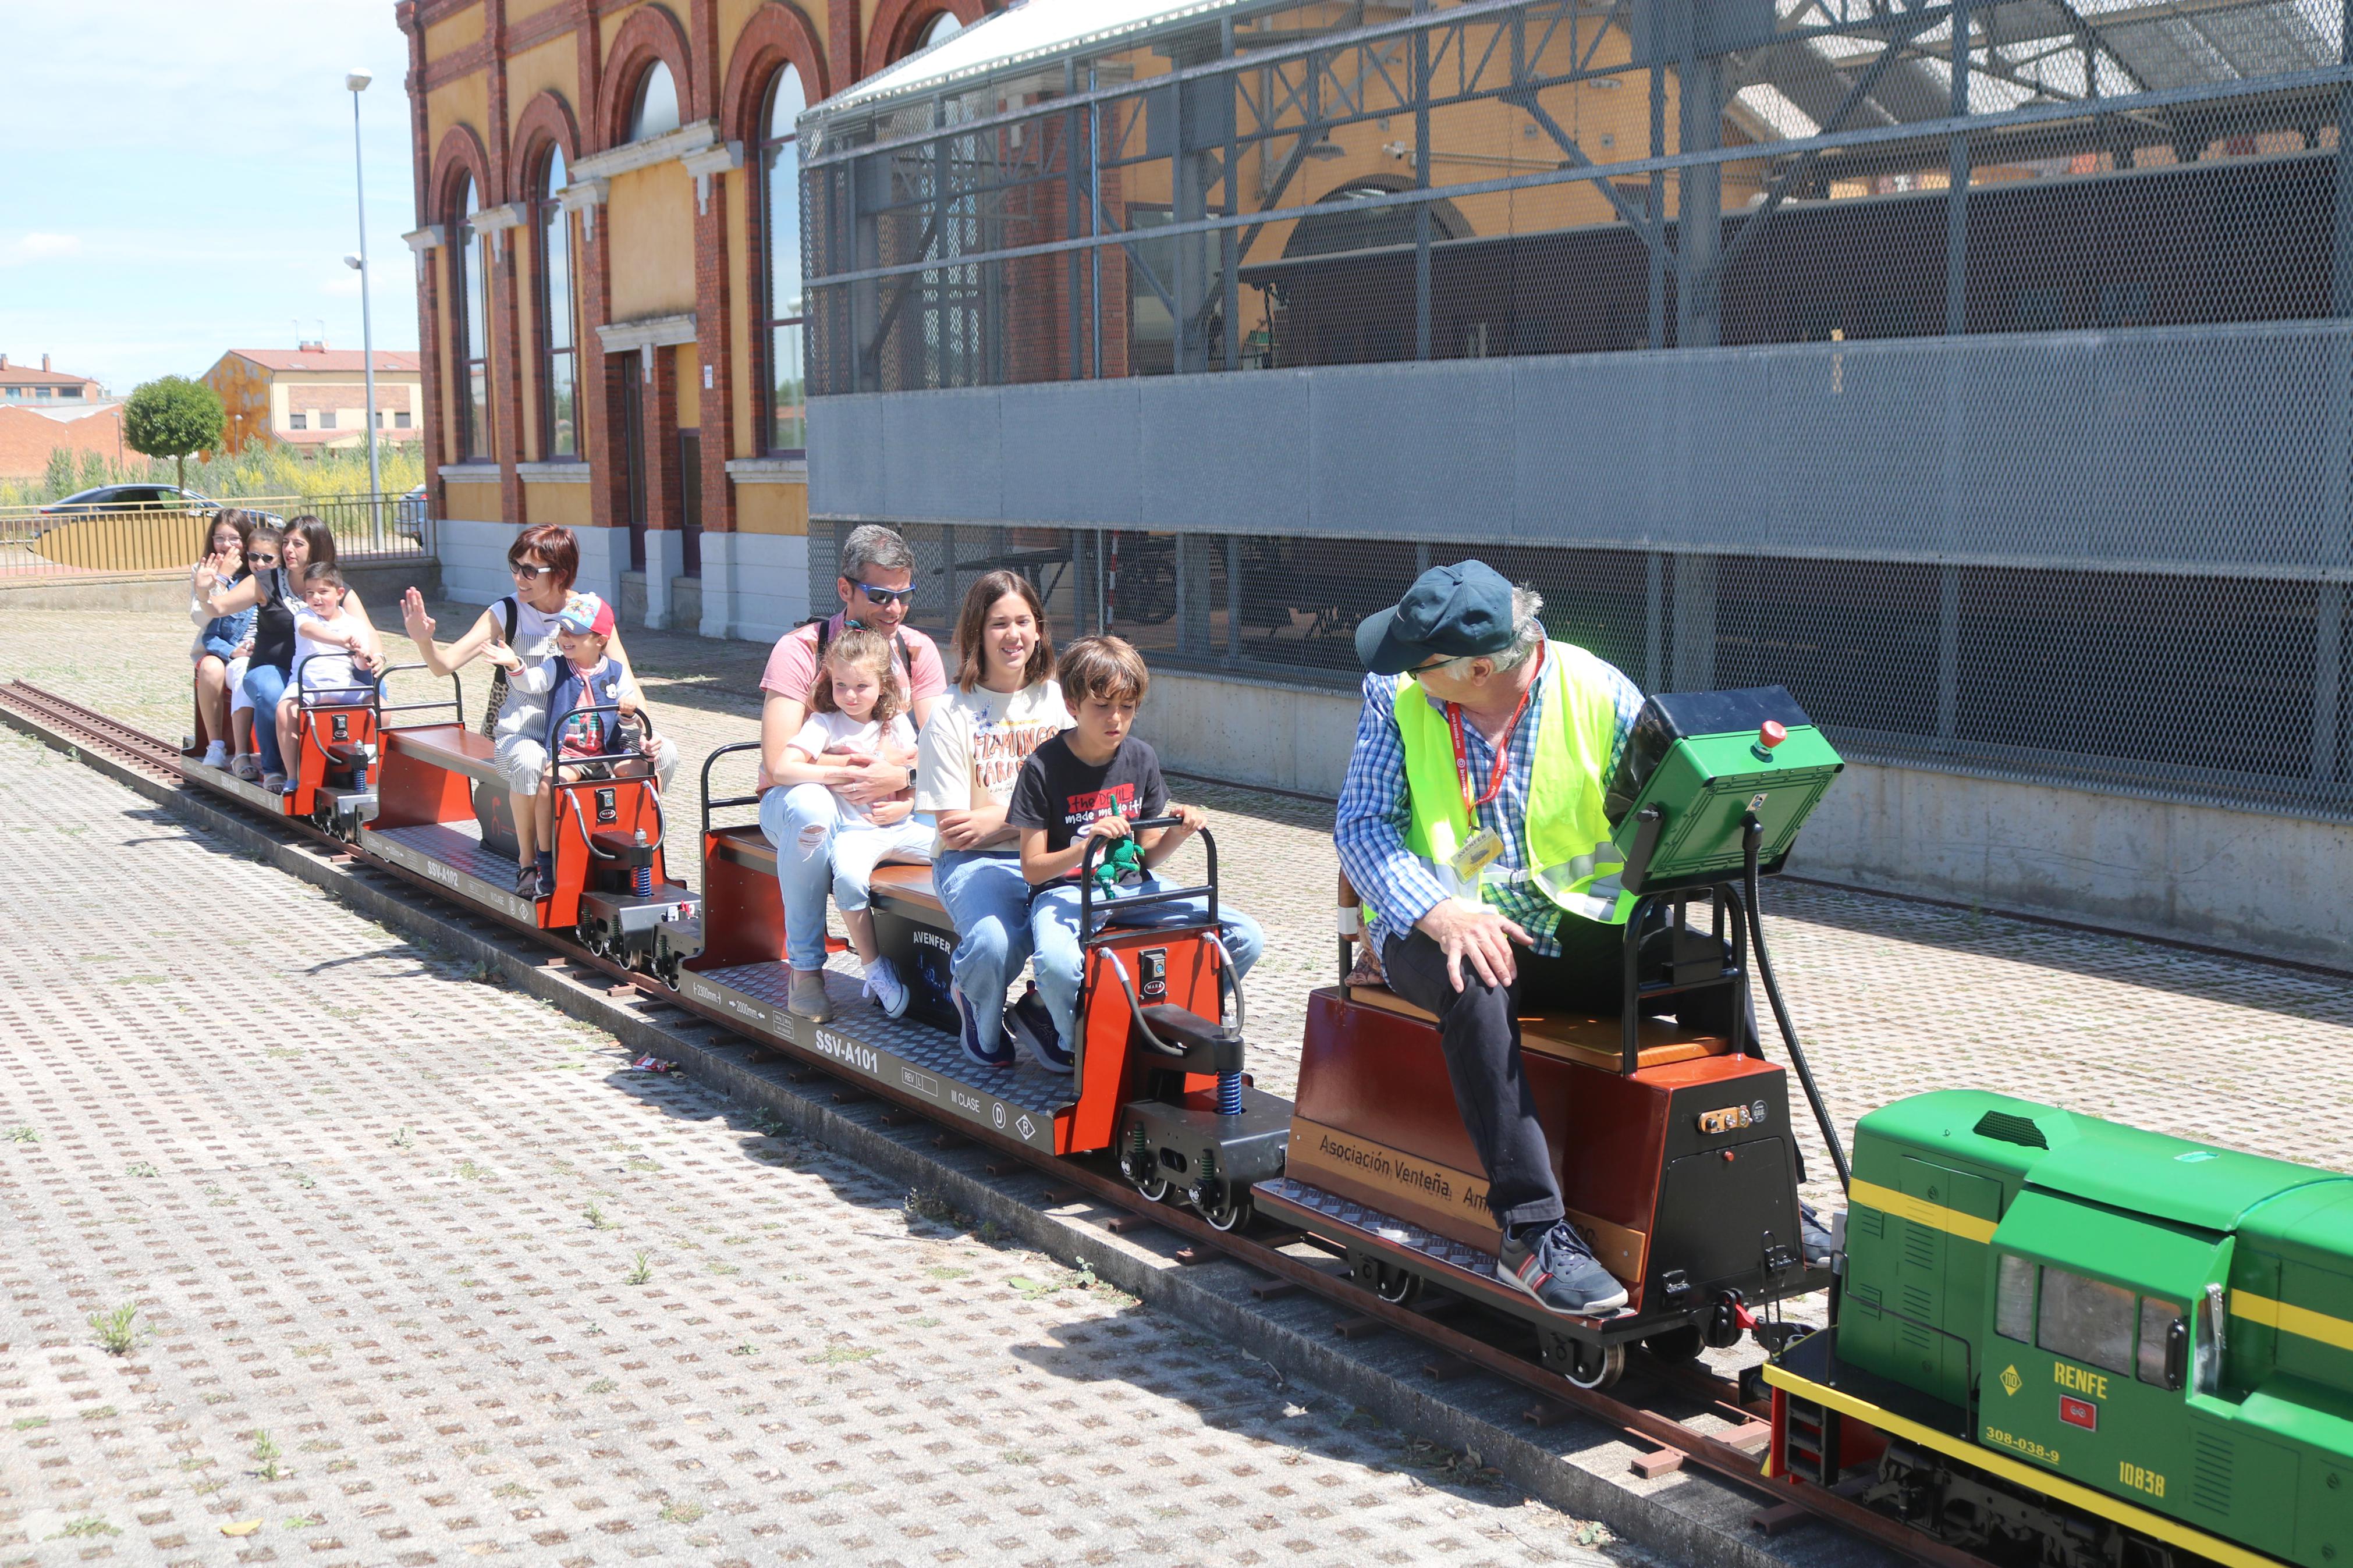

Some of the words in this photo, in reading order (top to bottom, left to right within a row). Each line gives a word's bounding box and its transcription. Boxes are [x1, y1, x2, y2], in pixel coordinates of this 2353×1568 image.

[1460, 769, 1468, 798] brembo
[1064, 810, 1095, 824] made
[1098, 808, 1113, 817] me
[1129, 797, 1142, 815] it!
[1071, 797, 1095, 810] the
[1457, 834, 1486, 859] AVENFER
[427, 861, 459, 887] SSV-A102
[913, 931, 950, 955] AVENFER
[815, 1030, 878, 1073] SSV-A101
[904, 1071, 914, 1083] REV
[917, 1077, 921, 1087] L
[958, 1093, 981, 1113] CLASE
[996, 1107, 1003, 1124] D
[1022, 1120, 1029, 1135] R
[1319, 1135, 1390, 1175] Asociación
[1395, 1159, 1449, 1196] Venteña
[2004, 1373, 2017, 1388] 110
[2054, 1361, 2108, 1400] RENFE
[1986, 1426, 2060, 1463] 308-038-9
[2119, 1460, 2165, 1498] 10838
